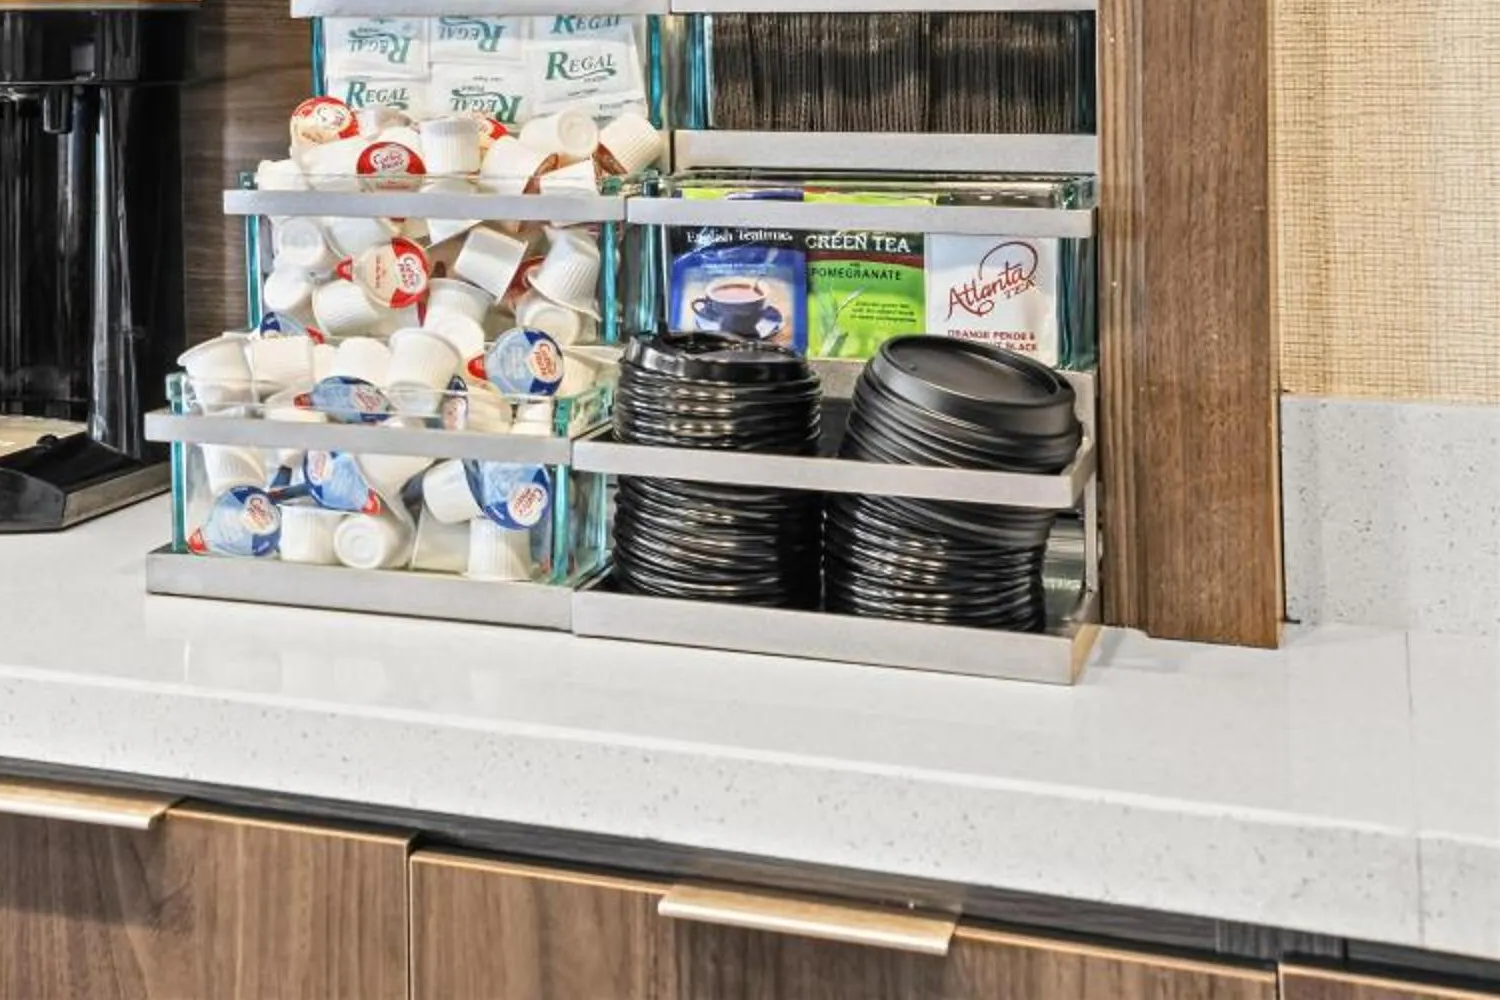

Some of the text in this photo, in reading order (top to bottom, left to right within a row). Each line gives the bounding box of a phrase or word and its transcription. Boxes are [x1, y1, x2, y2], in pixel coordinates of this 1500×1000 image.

[348, 32, 412, 64] REGAL
[438, 21, 507, 53] REGAL
[545, 51, 616, 82] REGAL
[346, 81, 409, 108] REGAL
[450, 91, 523, 125] REGAL
[805, 234, 911, 253] GREEN TEA
[810, 266, 902, 281] POMEGRANATE
[947, 252, 1032, 319] Atlanta
[1003, 277, 1035, 300] TEA
[947, 329, 991, 339] ORANGE
[993, 331, 1027, 341] PEKOE
